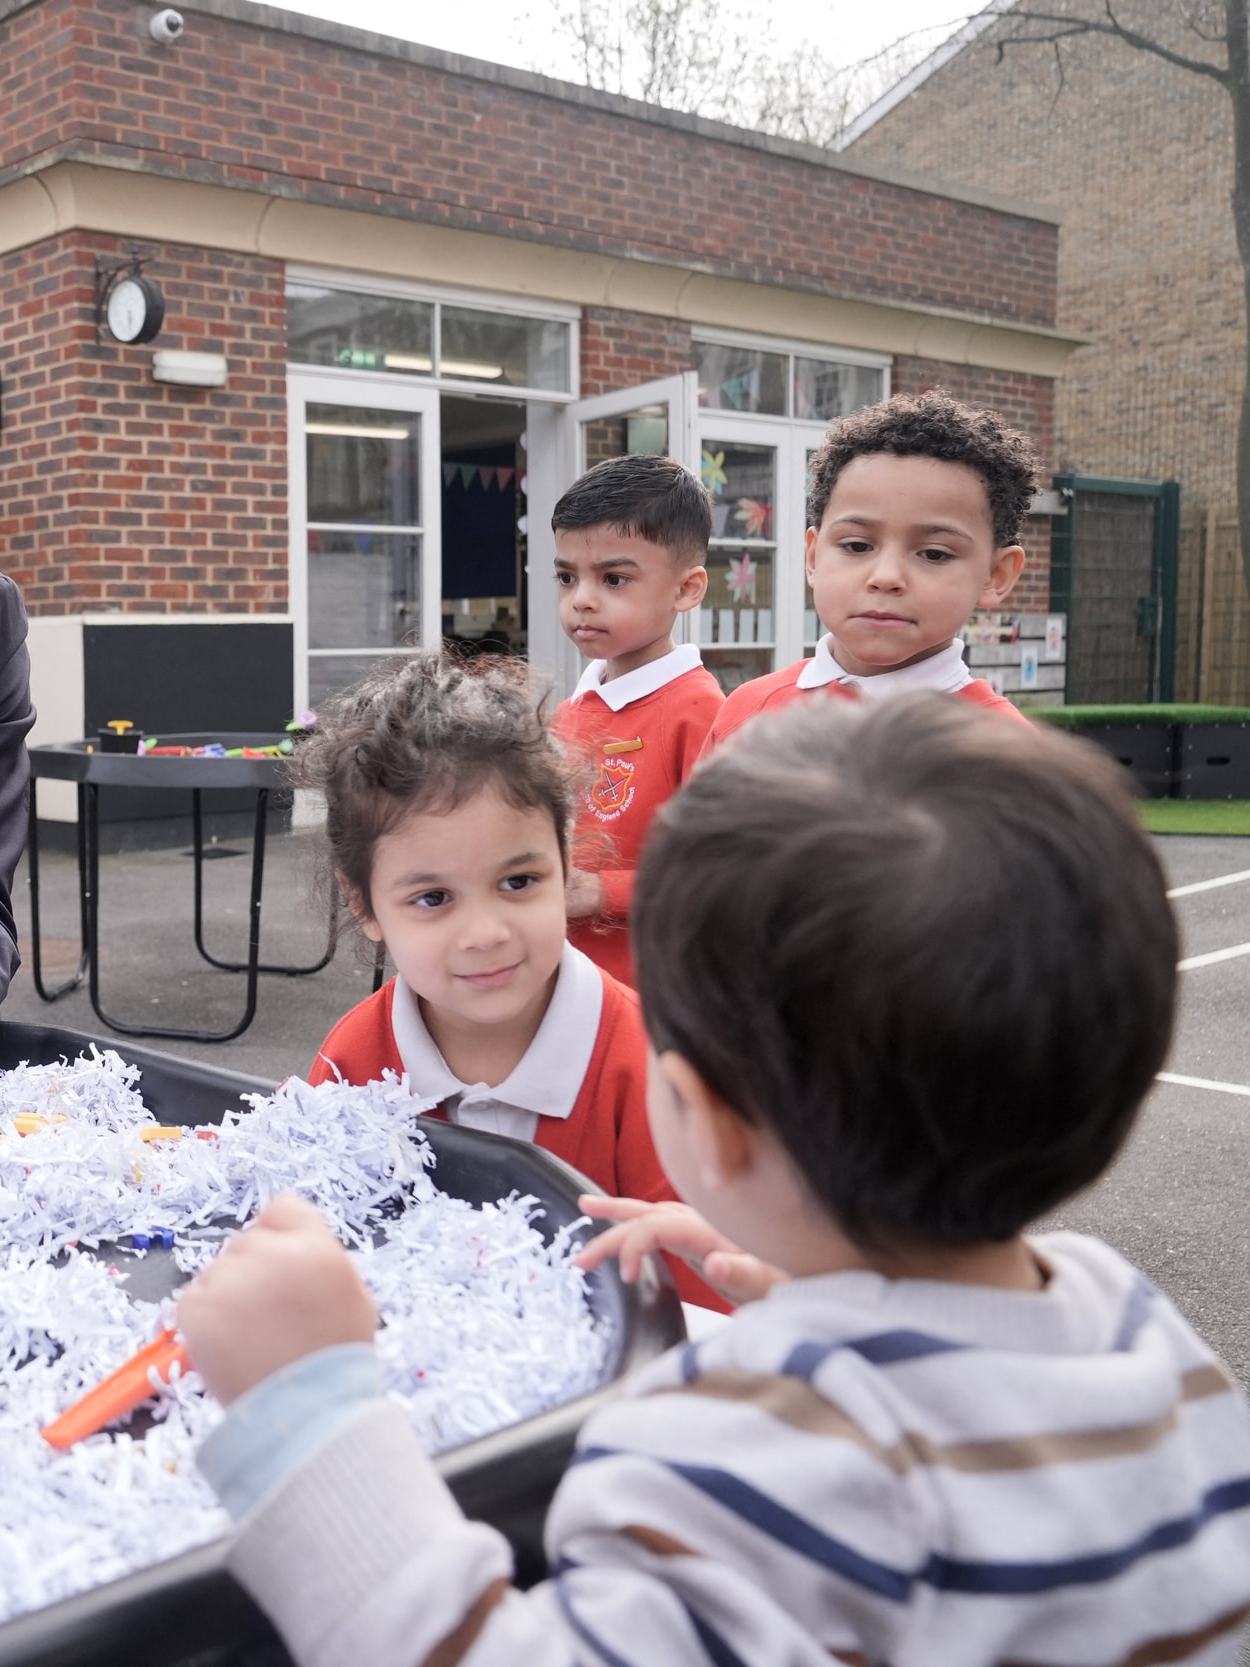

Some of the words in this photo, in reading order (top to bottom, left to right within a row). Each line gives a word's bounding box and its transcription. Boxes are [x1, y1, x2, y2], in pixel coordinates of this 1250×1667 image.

[605, 758, 615, 766] St.
[616, 758, 635, 772] Paul's
[588, 803, 596, 812] of
[595, 810, 620, 822] England
[619, 786, 635, 812] School
